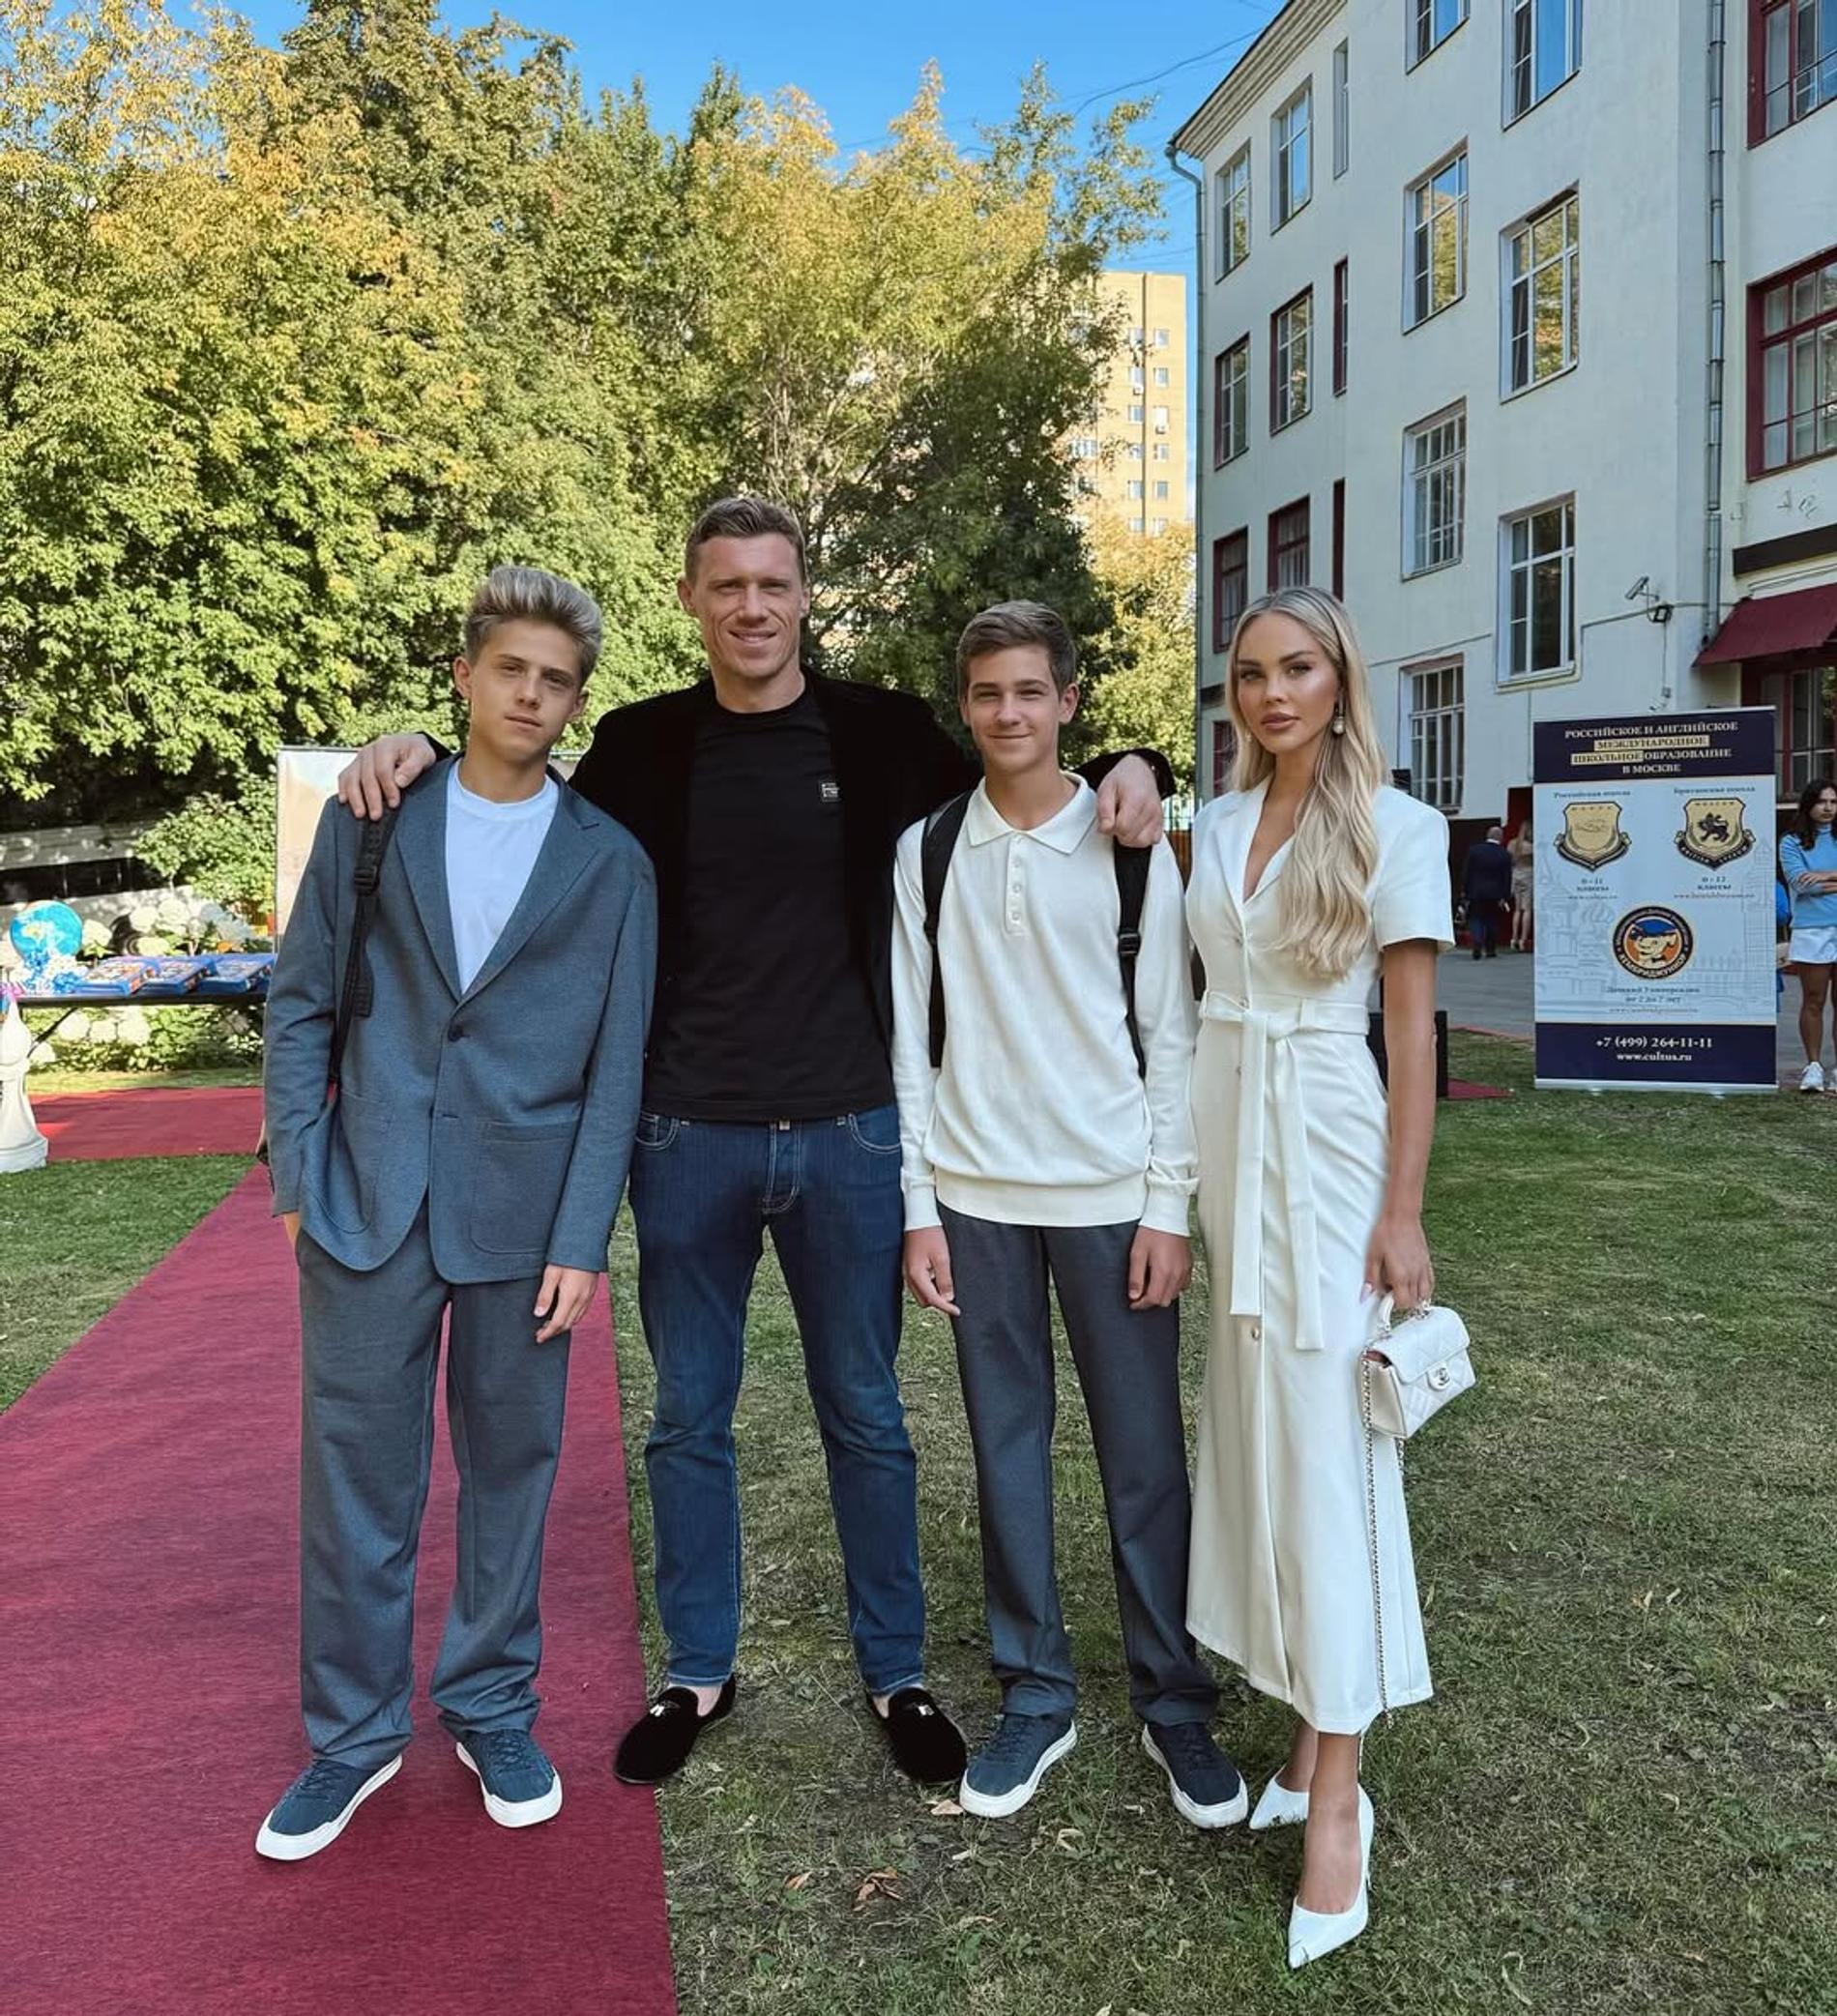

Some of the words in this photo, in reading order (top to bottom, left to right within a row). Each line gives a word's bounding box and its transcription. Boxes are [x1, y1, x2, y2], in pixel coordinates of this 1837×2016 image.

[1565, 726, 1642, 738] РОССИЙСКОЕ
[1644, 725, 1653, 734] И
[1655, 721, 1738, 734] АНГЛИЙСКОЕ
[1597, 737, 1705, 748] МЕЖДУНАРОДНОЕ
[1573, 751, 1643, 764] ШКОЛЬНОЕ
[1645, 748, 1732, 760] ОБРАЗОВАНИЕ
[1632, 764, 1681, 774] МОСКВЕ
[1596, 1037, 1612, 1047] +7
[1615, 1037, 1647, 1048] (499)
[1651, 1037, 1712, 1048] 264-11-11
[1617, 1051, 1692, 1061] www.cultus.ru
